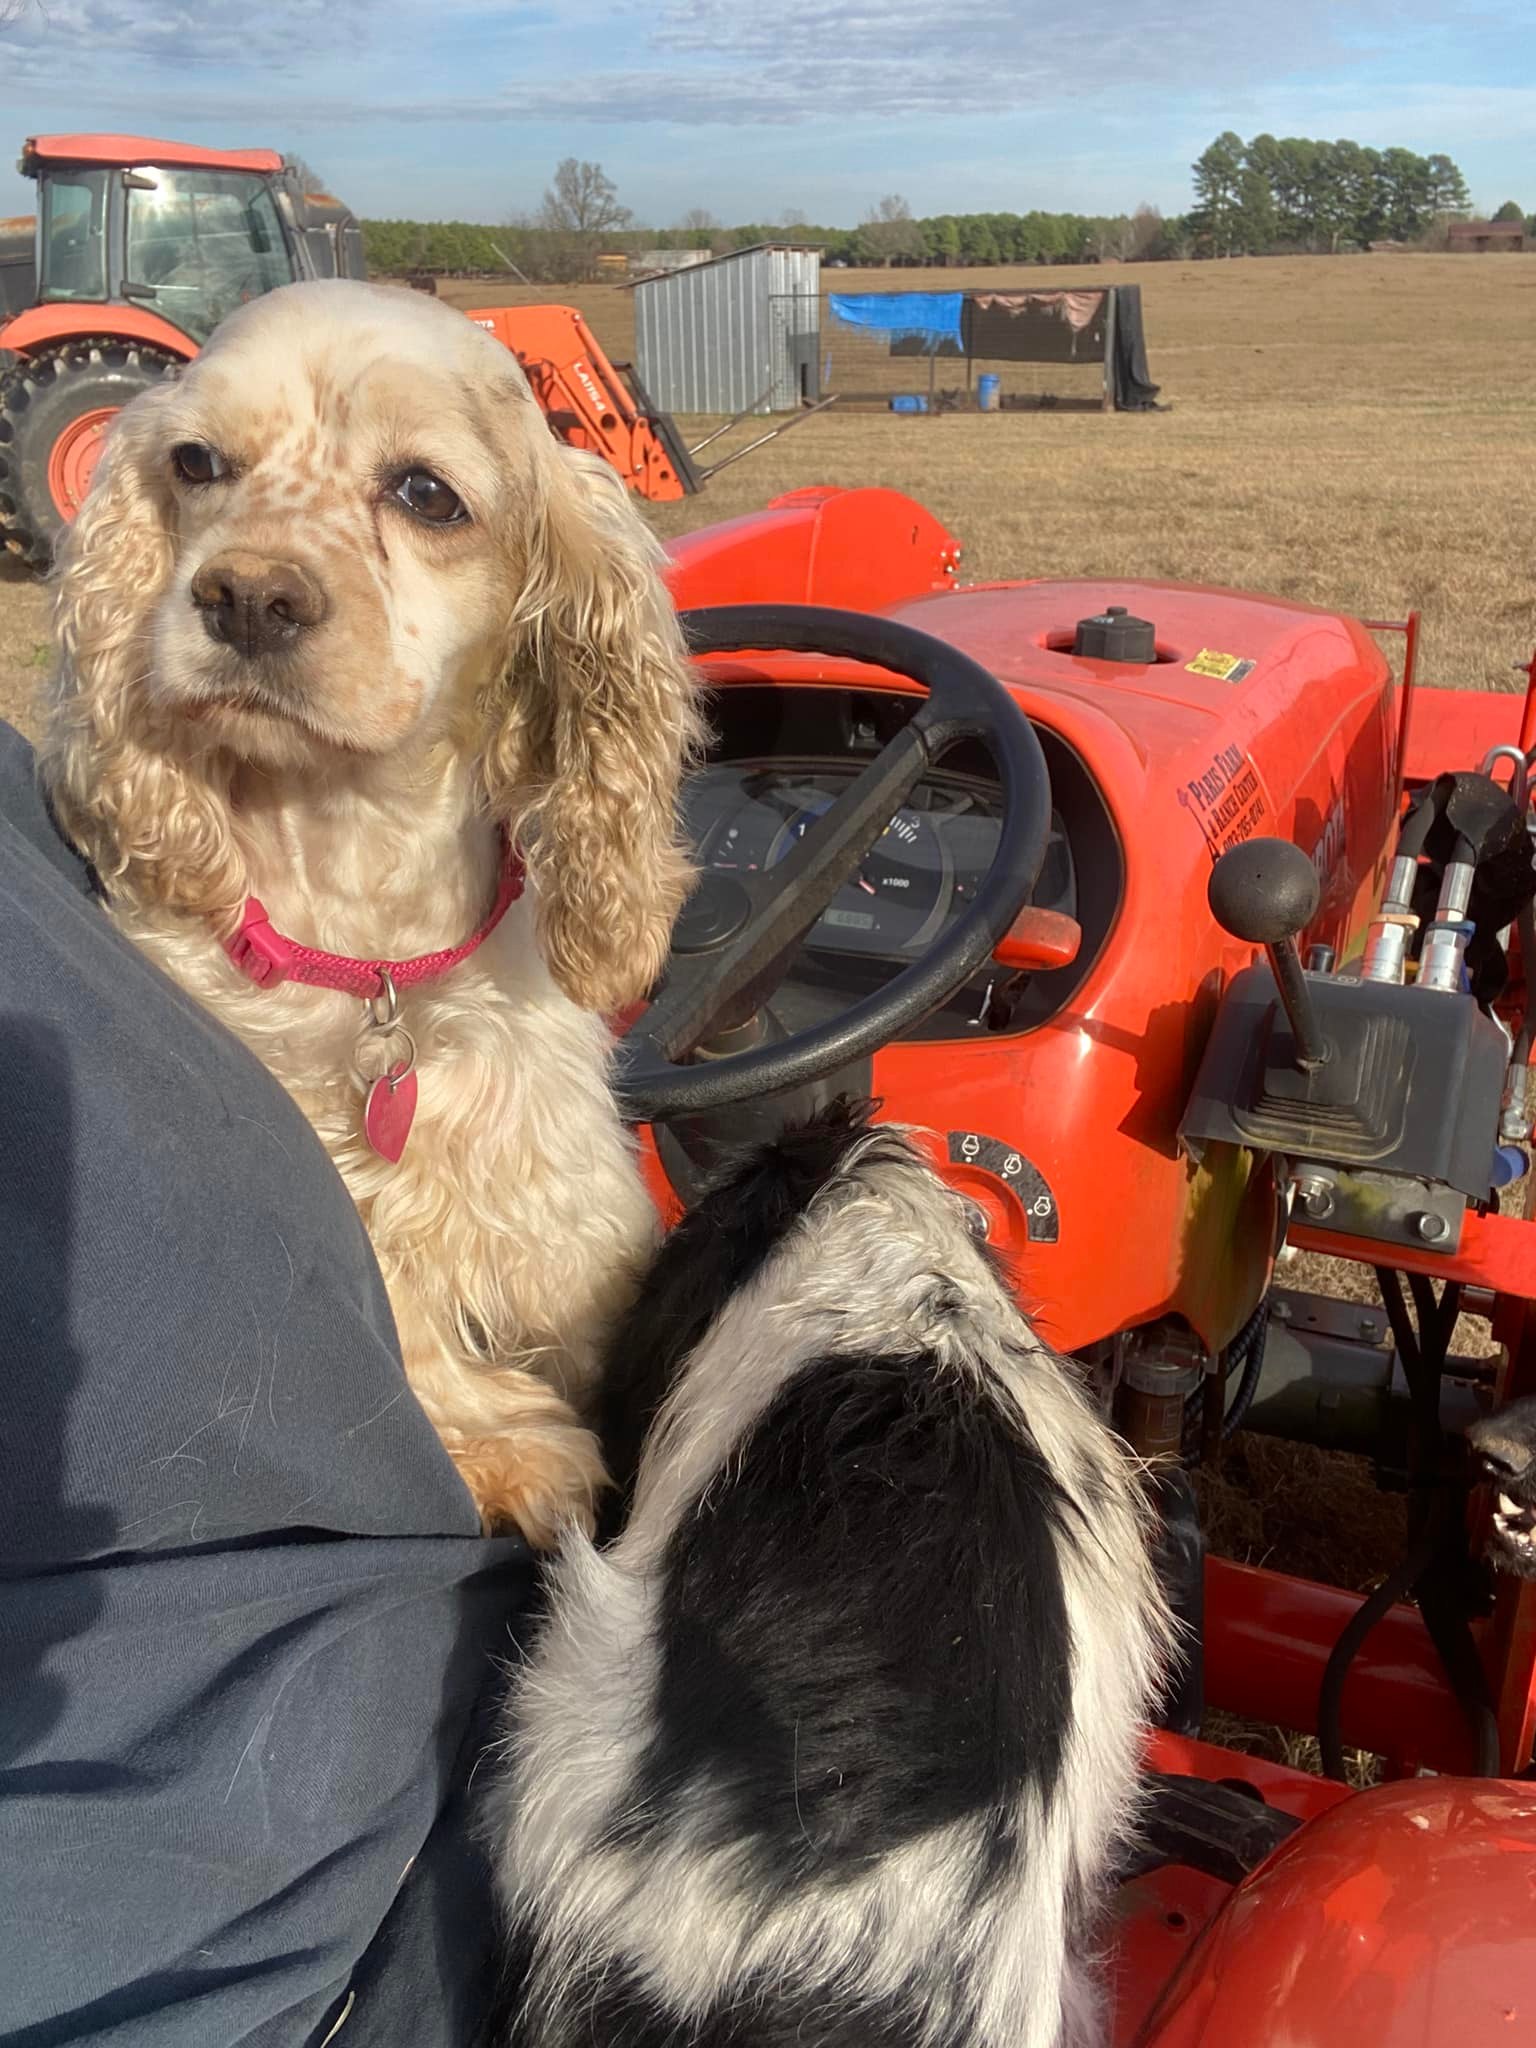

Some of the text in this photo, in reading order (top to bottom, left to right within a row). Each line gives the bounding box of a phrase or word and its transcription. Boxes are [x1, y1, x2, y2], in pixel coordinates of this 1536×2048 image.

[1187, 743, 1246, 811] PARIS FARM
[882, 876, 910, 888] x1000
